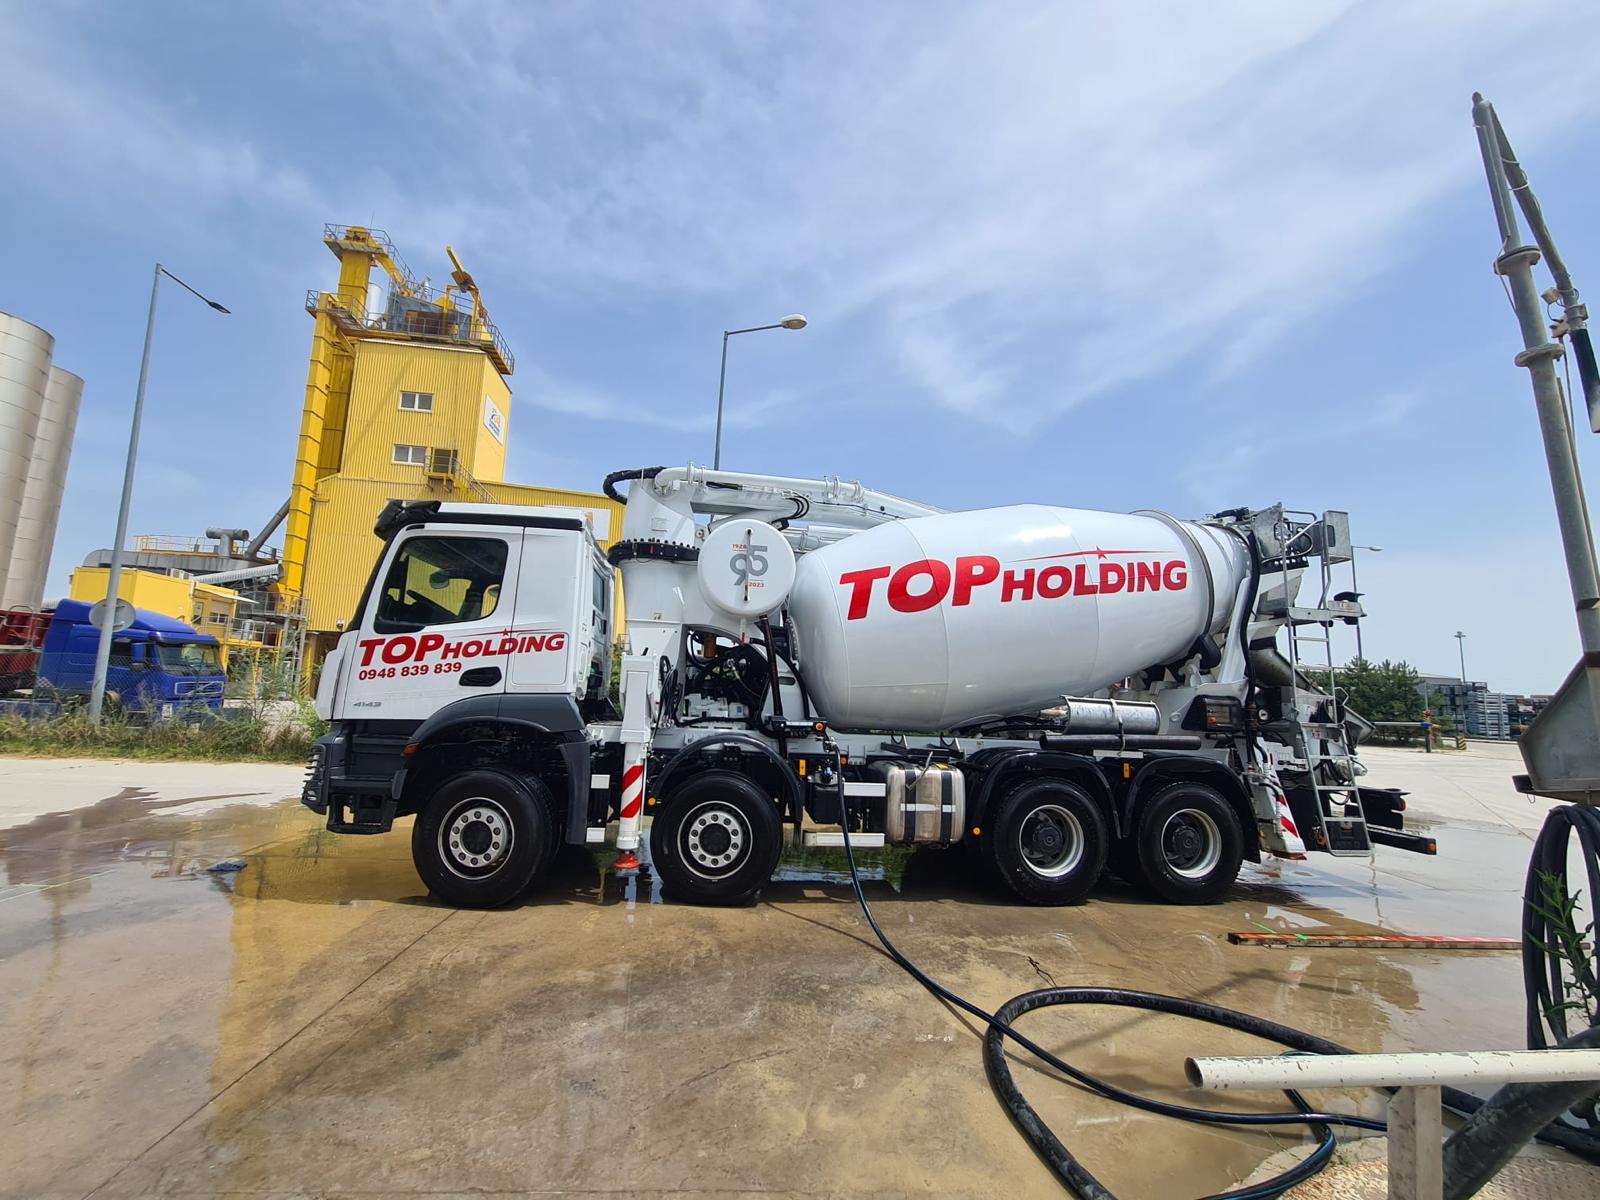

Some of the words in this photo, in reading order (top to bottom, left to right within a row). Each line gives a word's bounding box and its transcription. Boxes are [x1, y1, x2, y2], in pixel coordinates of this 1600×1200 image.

[840, 555, 1001, 620] TOP
[1001, 560, 1188, 602] HOLDING
[359, 634, 444, 667] TOP
[441, 633, 565, 660] HOLDING
[359, 667, 396, 681] 0948
[401, 664, 429, 677] 839
[433, 662, 462, 674] 839
